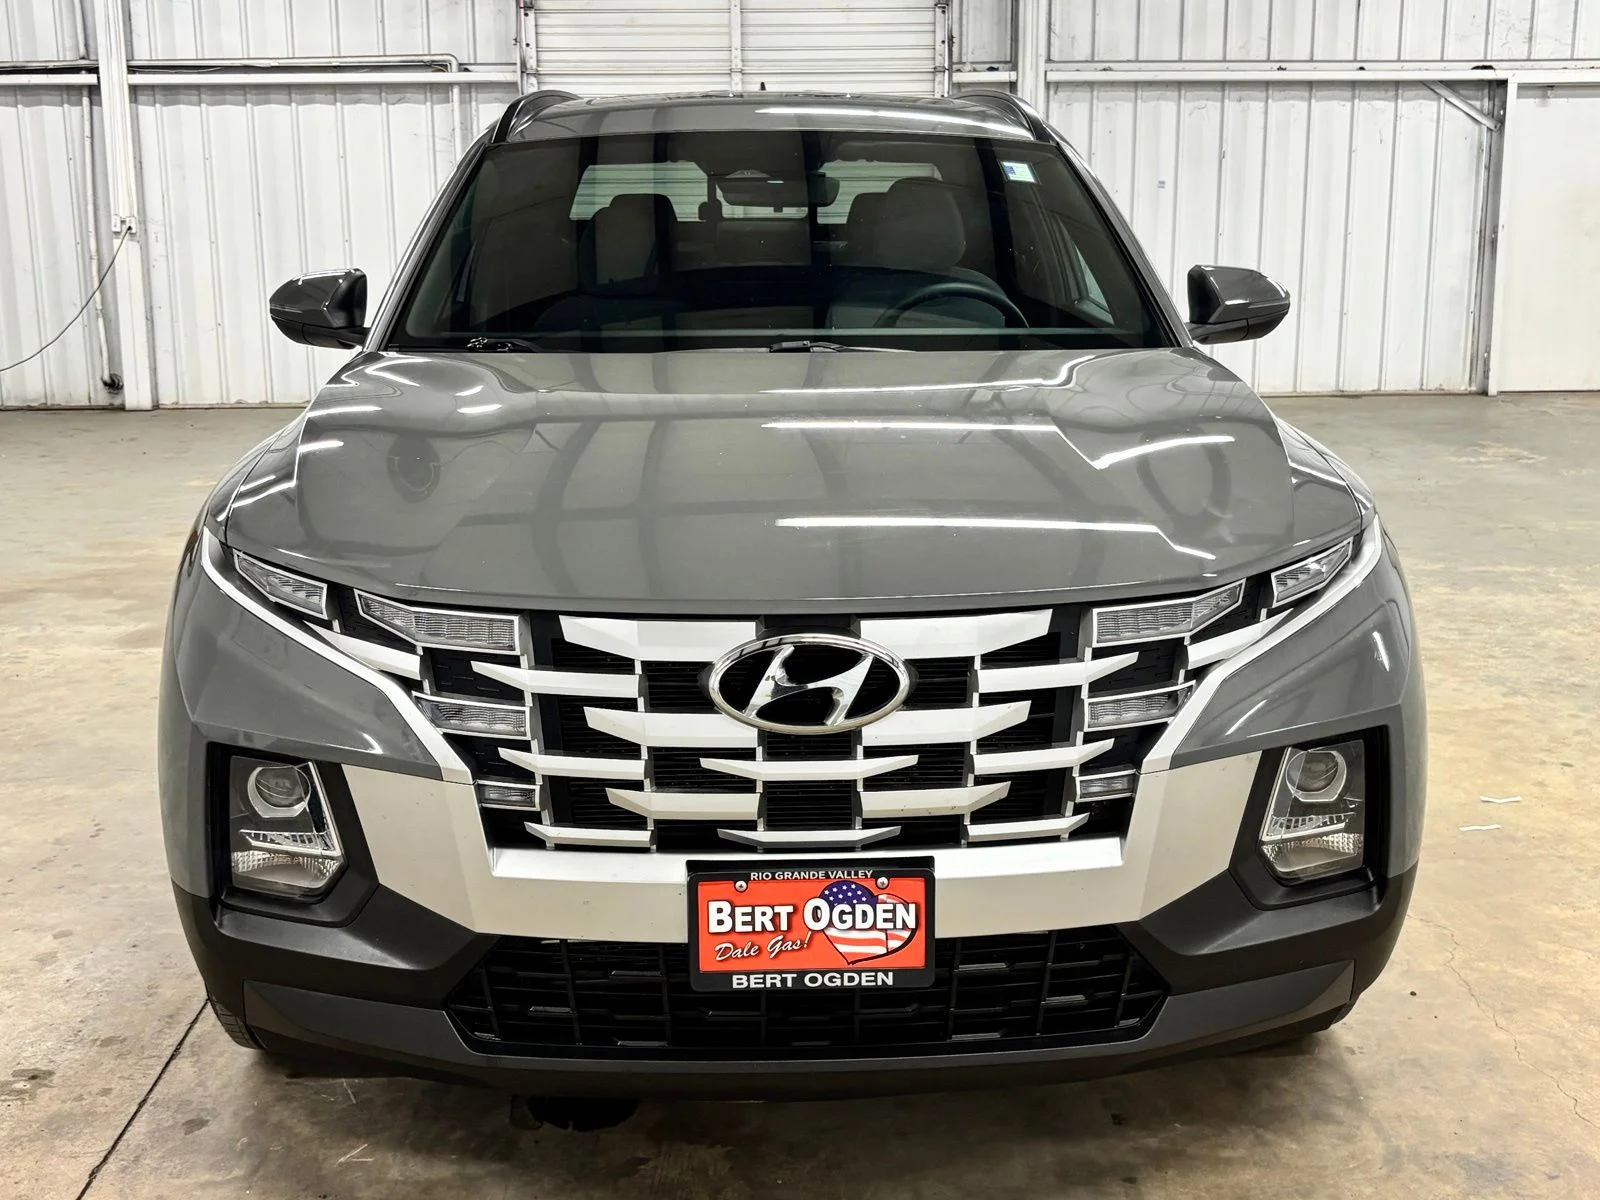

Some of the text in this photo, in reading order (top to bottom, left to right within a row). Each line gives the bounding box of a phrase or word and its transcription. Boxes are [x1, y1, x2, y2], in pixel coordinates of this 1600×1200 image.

[750, 869, 873, 881] RIO GRANDE VALLEY
[707, 897, 916, 934] BERT OGDEN
[714, 930, 813, 962] Dale Gas!
[732, 971, 894, 989] BERT OGDEN
